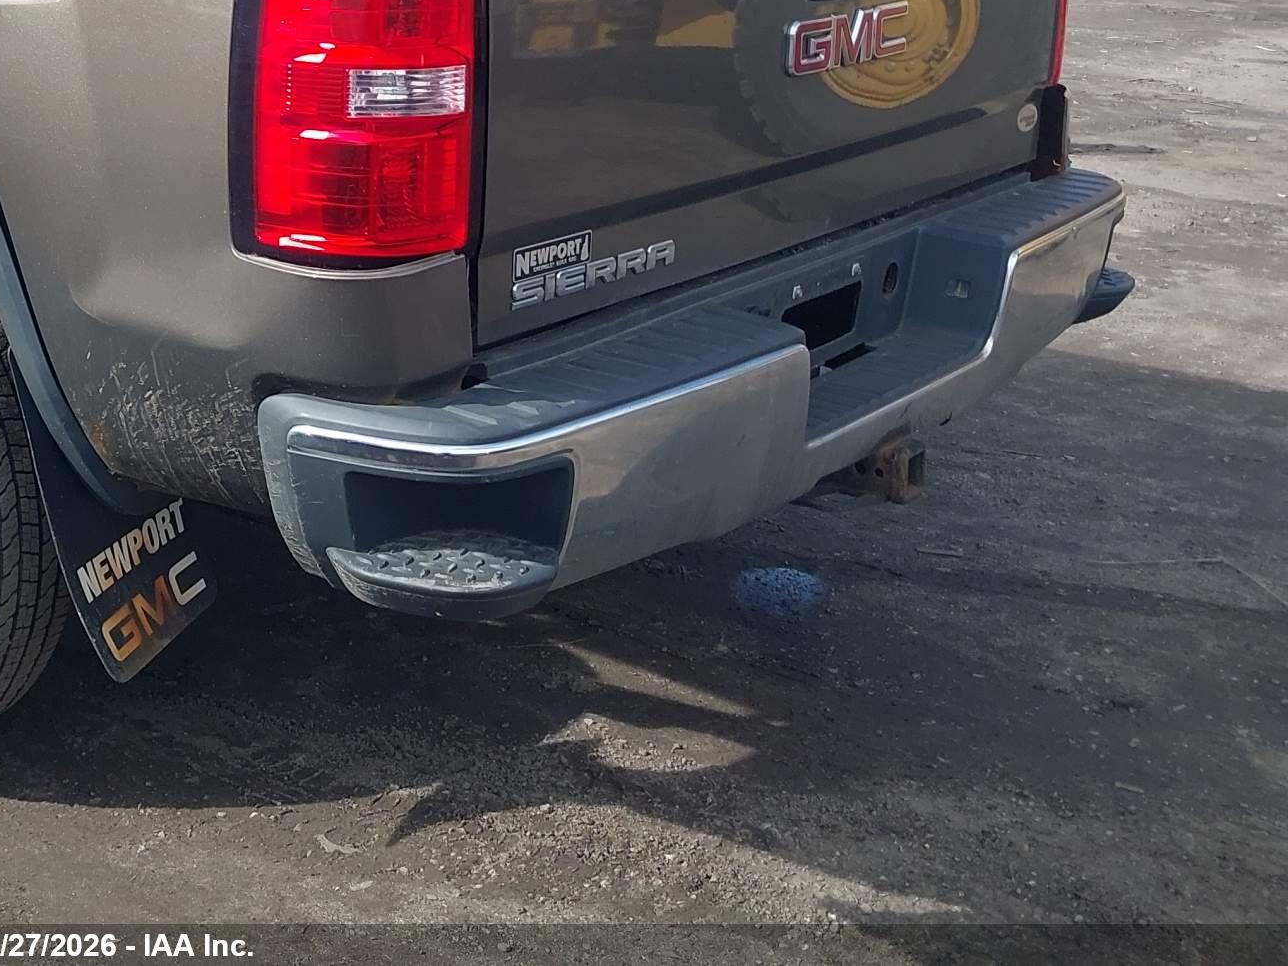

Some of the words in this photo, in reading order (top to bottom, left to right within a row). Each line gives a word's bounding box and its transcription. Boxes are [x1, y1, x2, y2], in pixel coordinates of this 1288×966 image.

[785, 0, 909, 77] GMC
[511, 239, 677, 311] SIERRA
[516, 238, 582, 277] NEWPORT
[76, 498, 185, 604] NEWPORT
[102, 550, 207, 662] GMC
